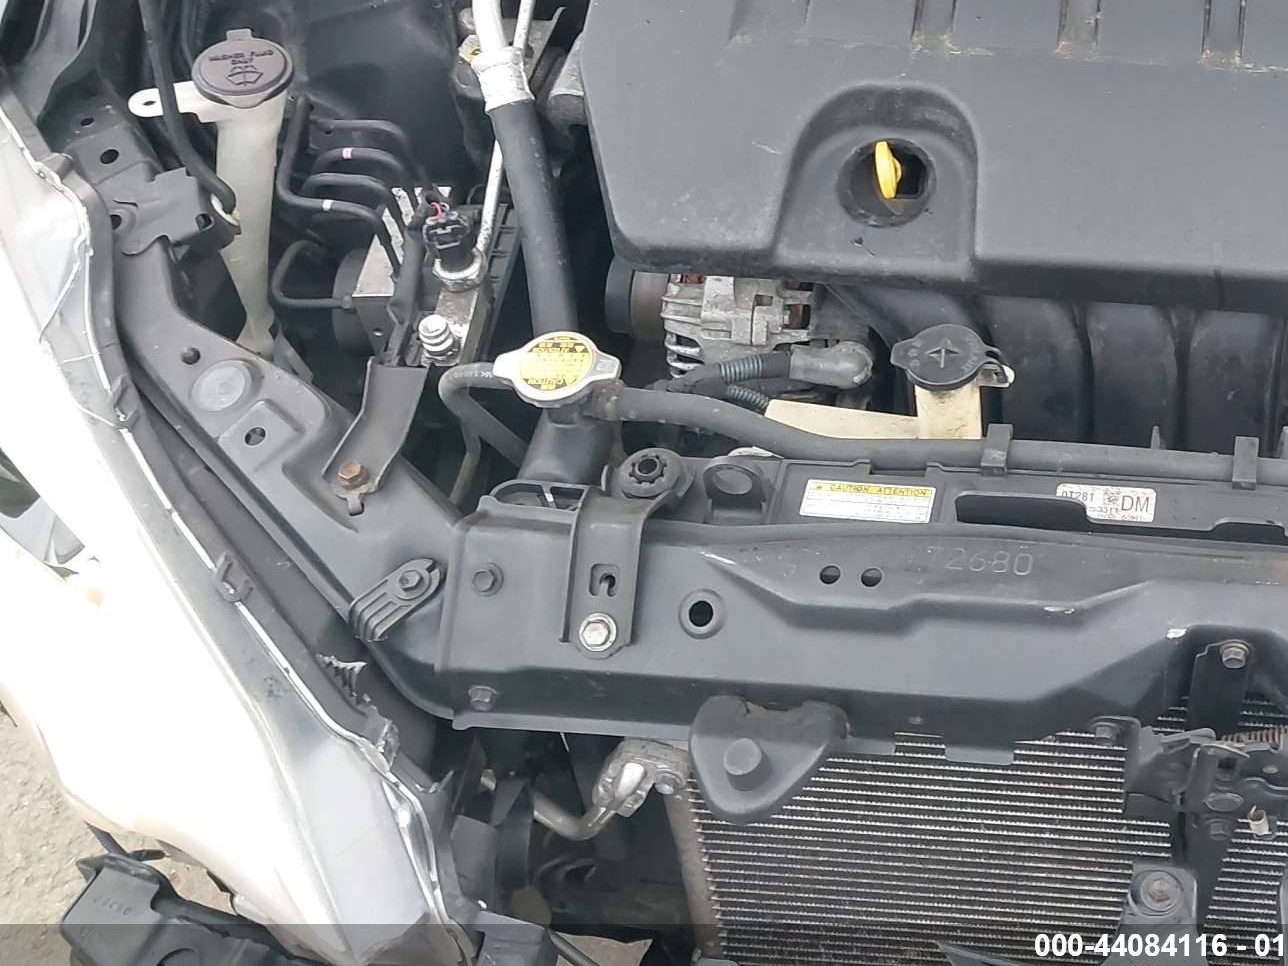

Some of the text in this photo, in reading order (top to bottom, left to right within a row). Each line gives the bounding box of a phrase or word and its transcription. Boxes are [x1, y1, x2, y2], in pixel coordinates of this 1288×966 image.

[831, 484, 926, 496] CAUTION ATTENTION
[1121, 495, 1150, 513] DM
